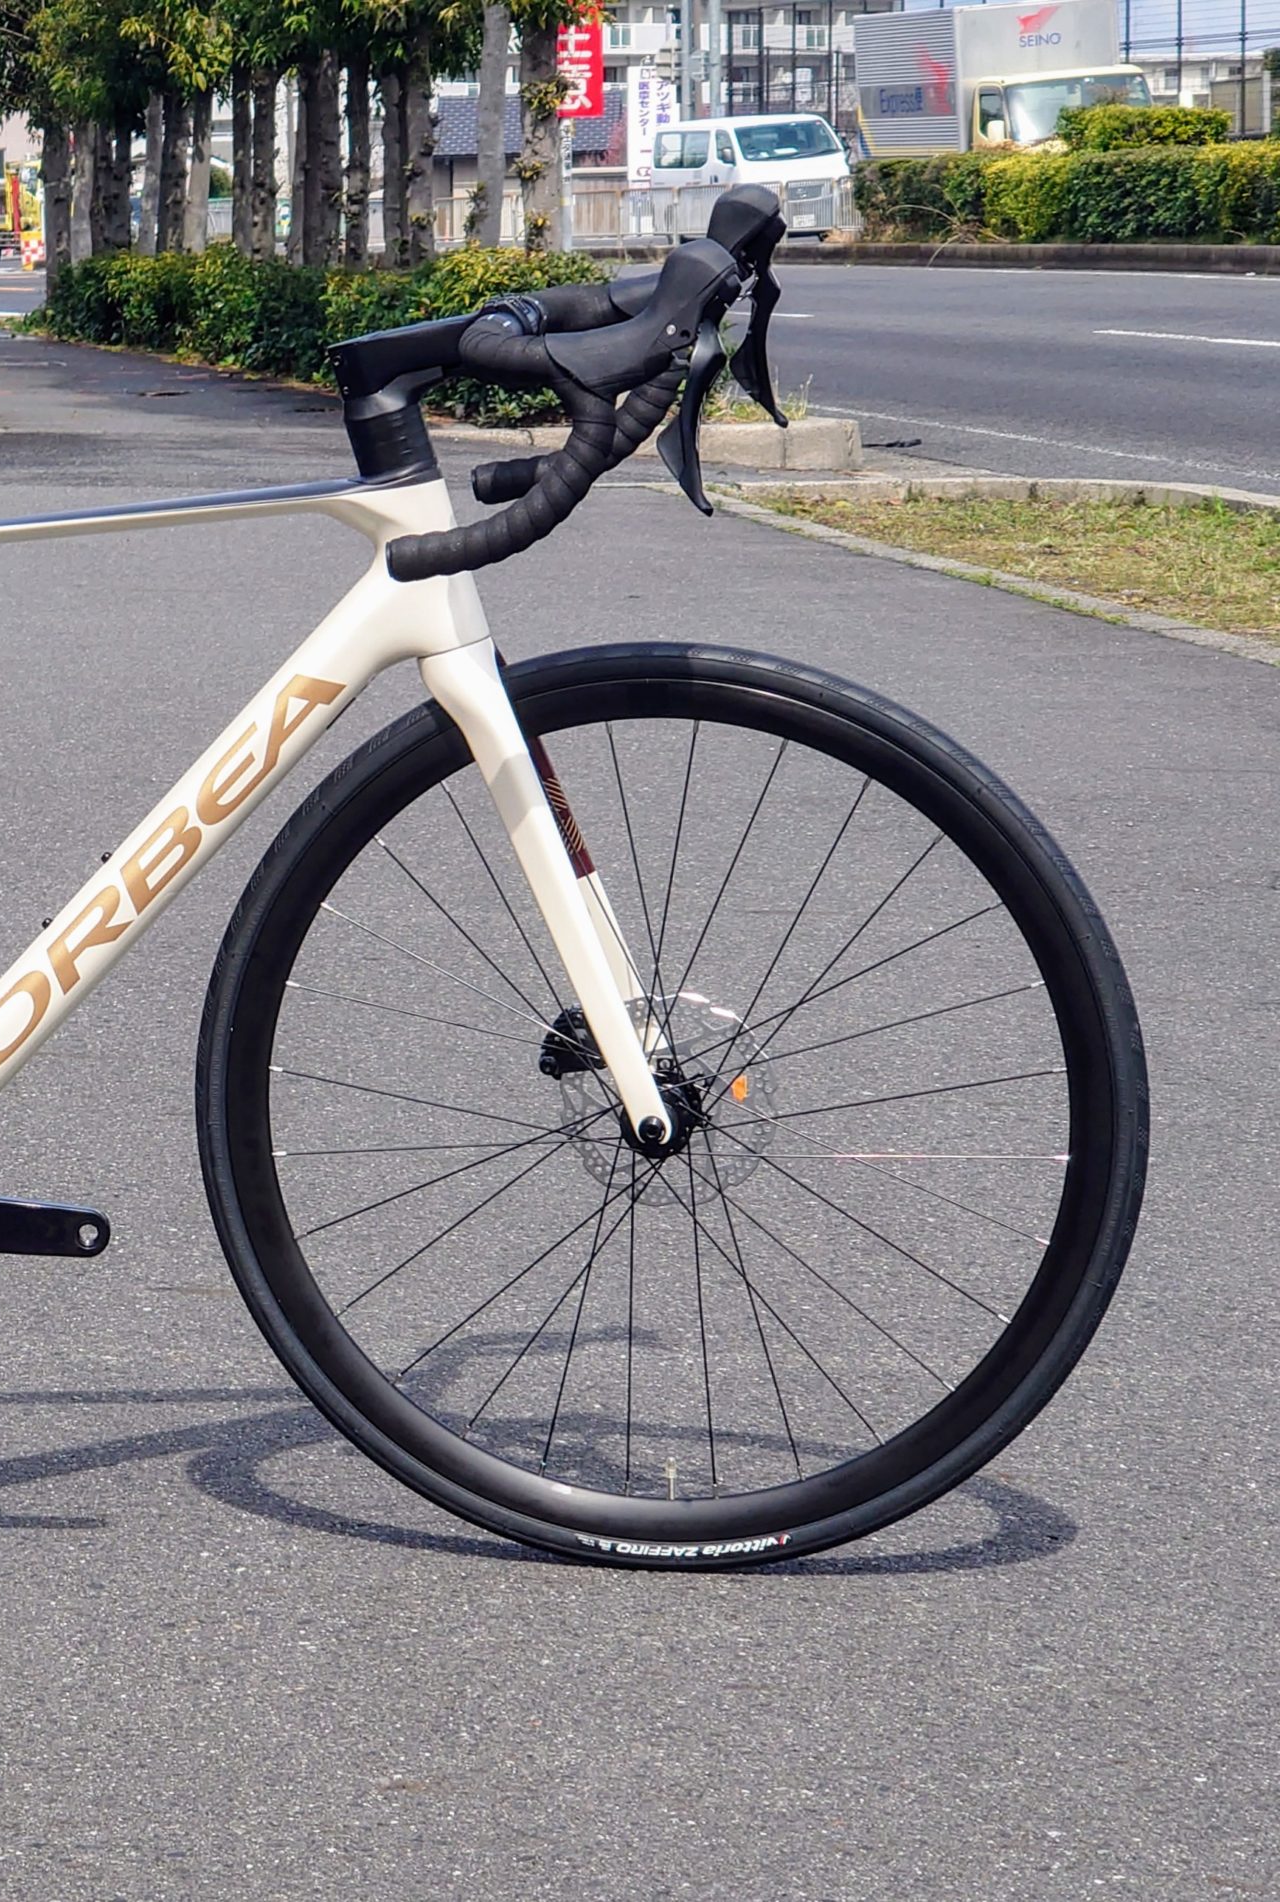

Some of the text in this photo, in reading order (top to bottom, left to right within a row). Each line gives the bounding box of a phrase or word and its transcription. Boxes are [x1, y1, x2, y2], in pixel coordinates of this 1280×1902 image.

[1019, 32, 1062, 47] SEINO
[616, 1542, 698, 1557] ZAFFIRO
[702, 1535, 779, 1557] vittoria
